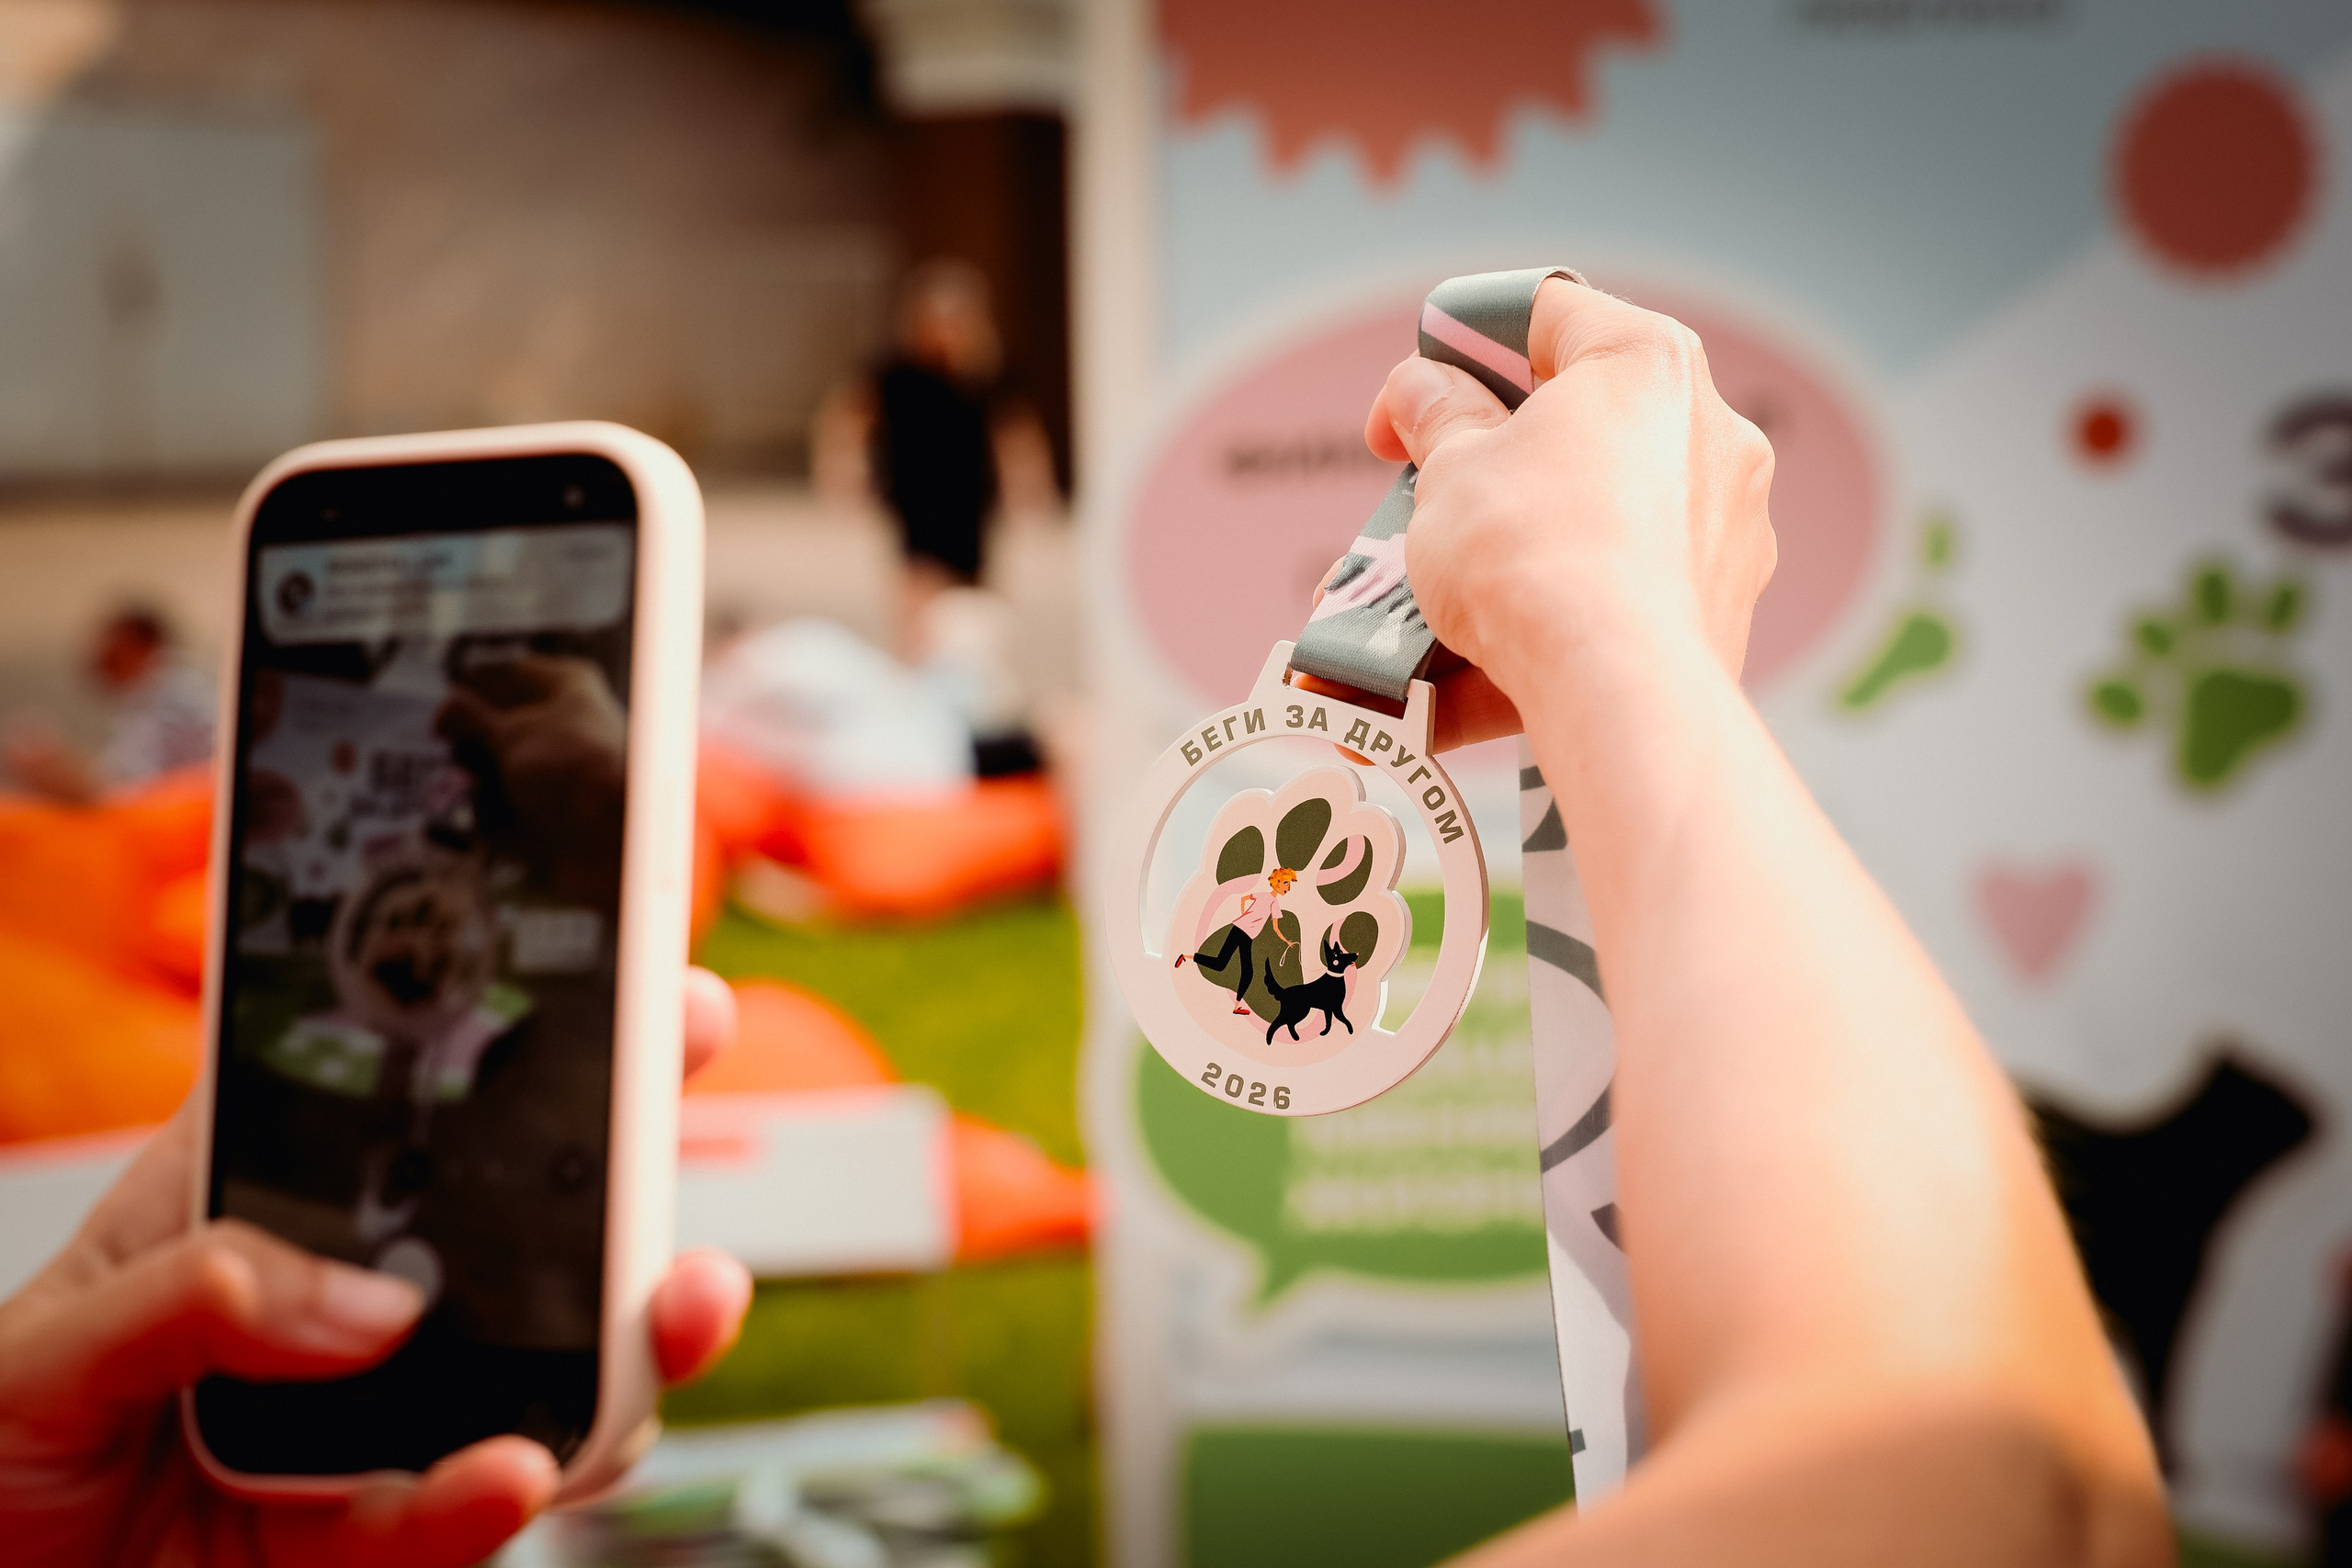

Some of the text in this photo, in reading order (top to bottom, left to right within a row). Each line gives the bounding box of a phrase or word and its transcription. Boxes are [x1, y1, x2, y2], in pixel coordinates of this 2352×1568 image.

[1180, 705, 1464, 845] БЕГИ ЗА ДРУГОМ
[1201, 1062, 1291, 1110] 2026
